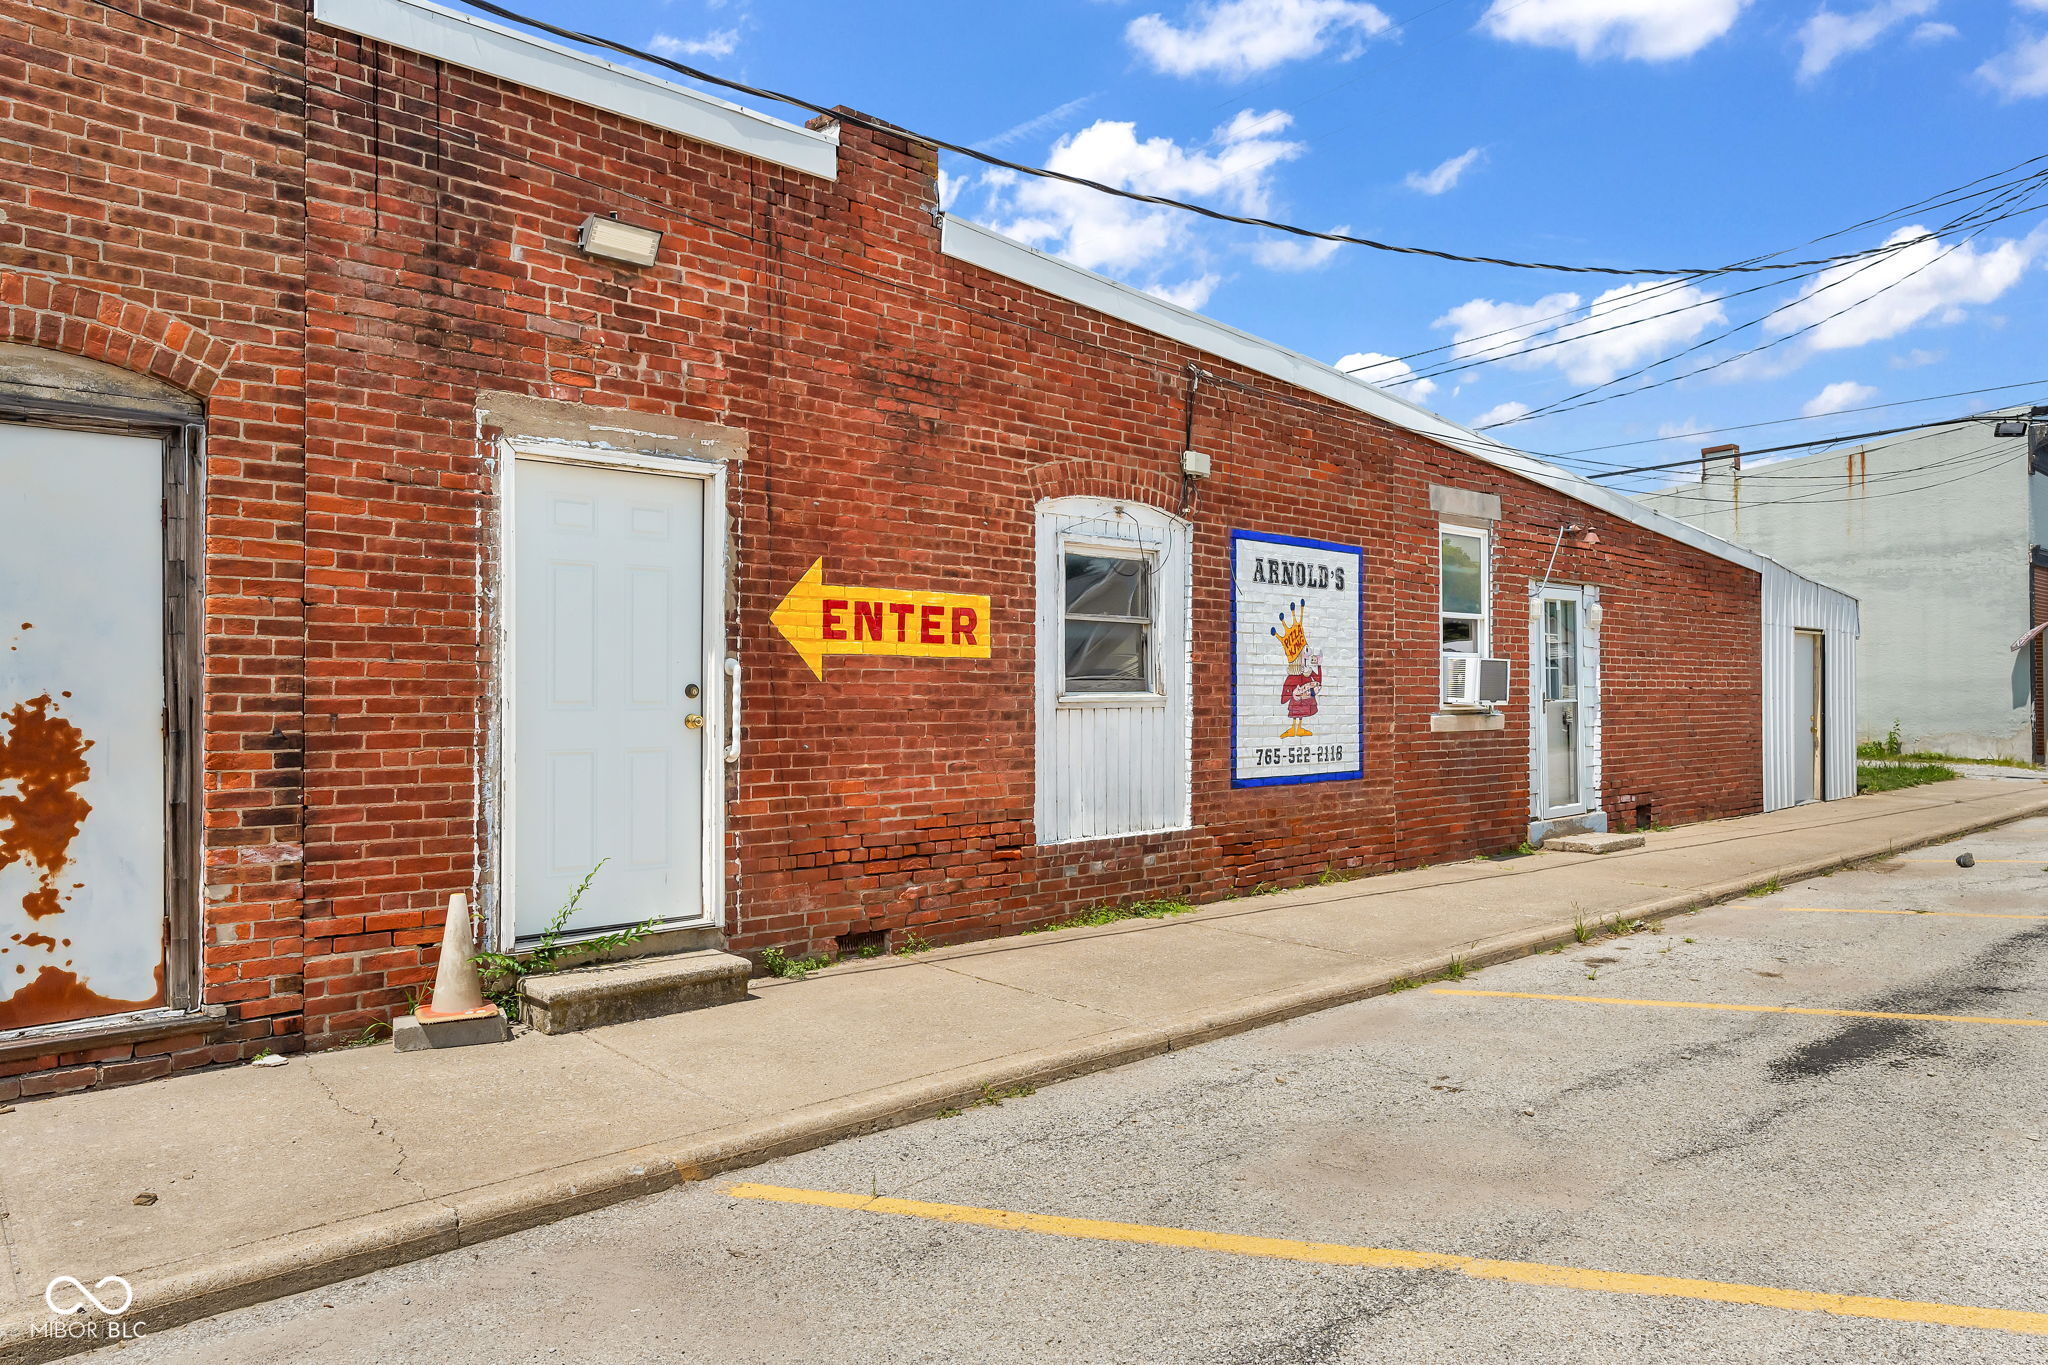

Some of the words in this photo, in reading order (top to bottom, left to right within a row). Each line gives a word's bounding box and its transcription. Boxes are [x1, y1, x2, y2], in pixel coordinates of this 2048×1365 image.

[1252, 557, 1345, 591] ARNOLD'S
[822, 600, 977, 645] ENTER
[1284, 624, 1303, 648] PIZZA
[1289, 635, 1305, 656] KING
[1255, 745, 1343, 765] 765-522-2118
